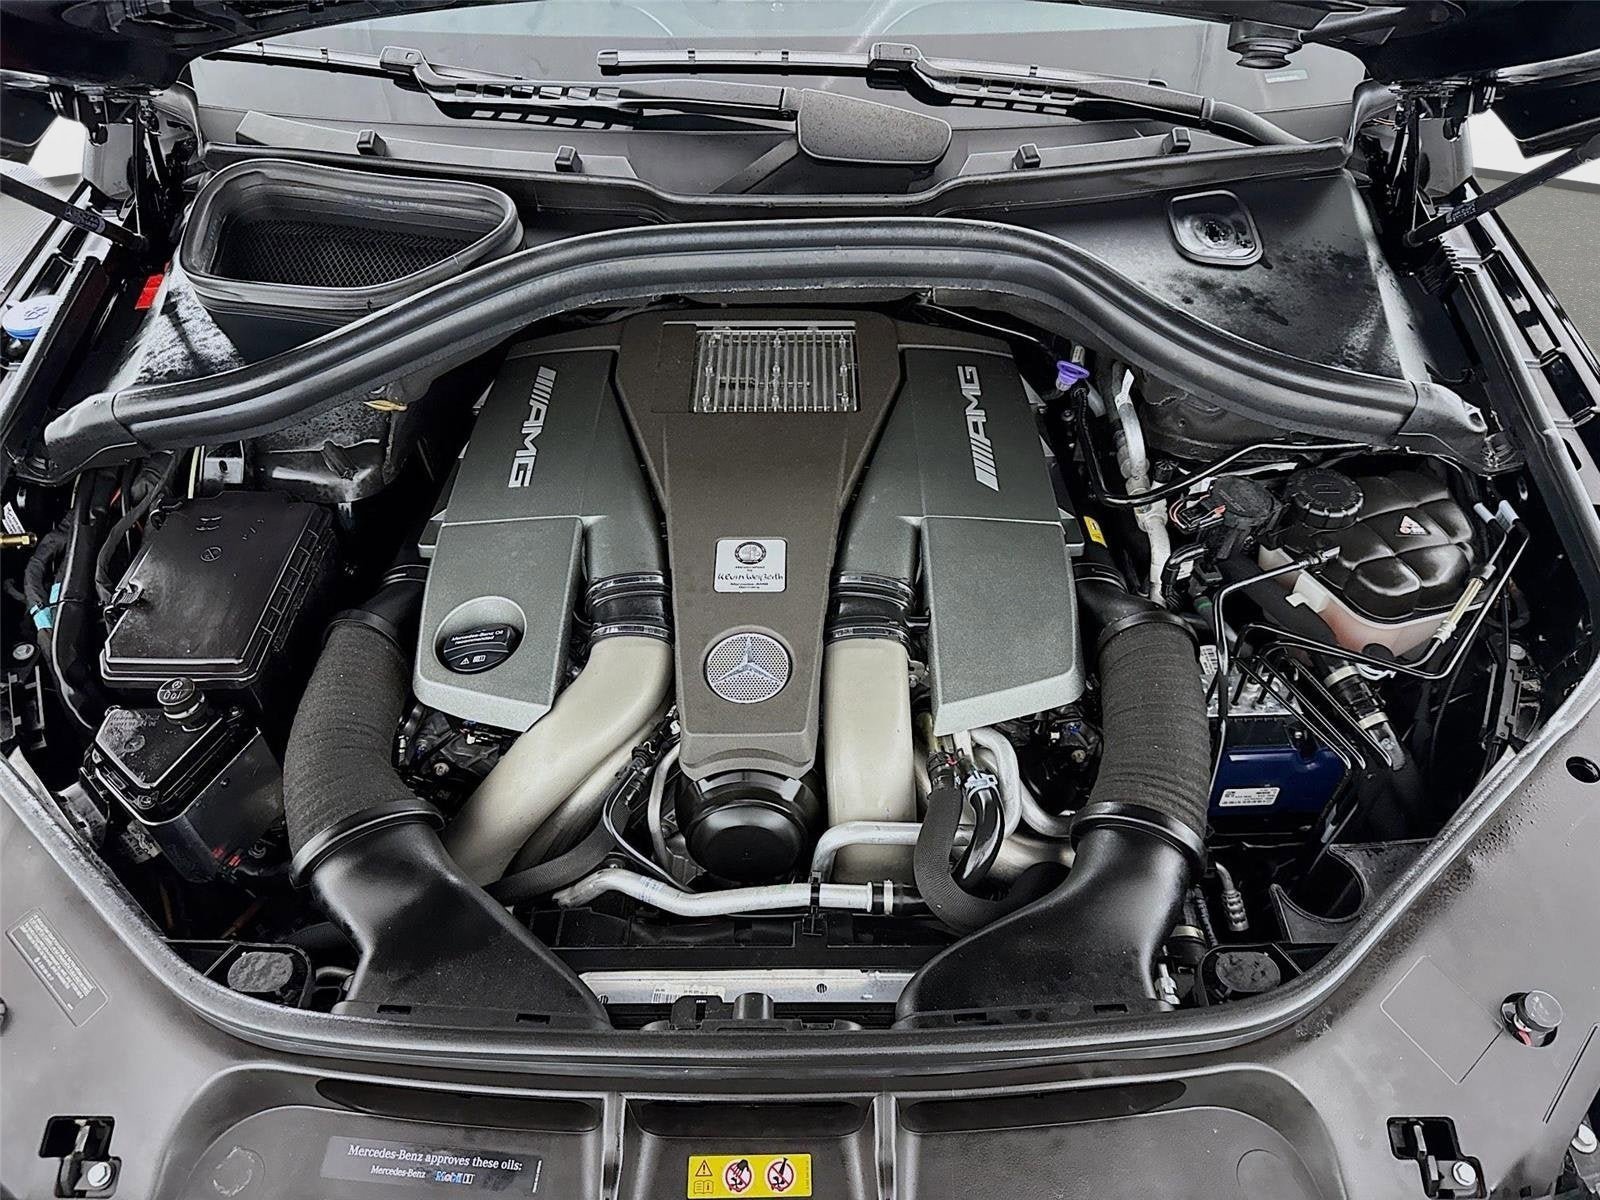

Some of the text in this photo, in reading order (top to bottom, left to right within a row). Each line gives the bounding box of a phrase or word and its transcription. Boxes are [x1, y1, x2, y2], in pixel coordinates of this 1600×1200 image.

[347, 1144, 523, 1171] Mercedes-Benz approves these oils:
[370, 1164, 426, 1178] Mercedes-Benz
